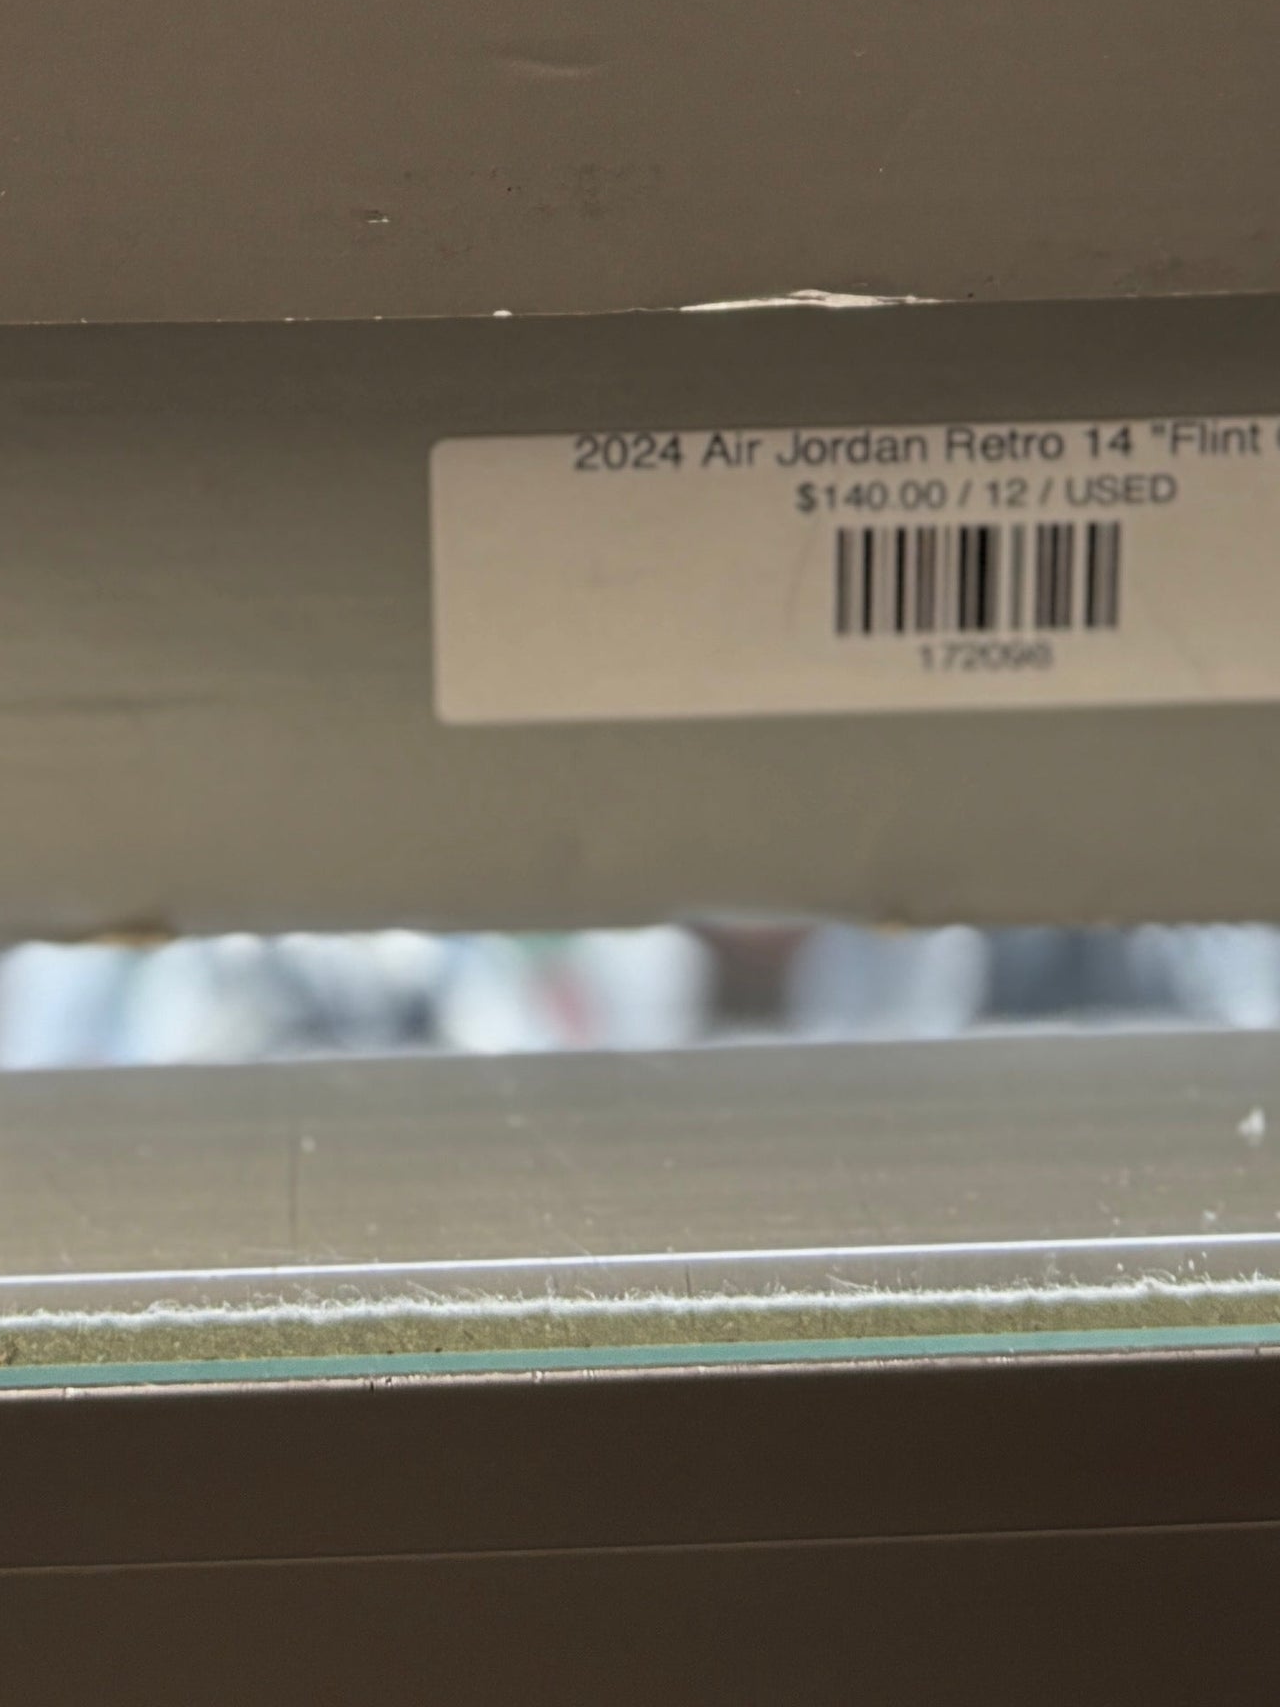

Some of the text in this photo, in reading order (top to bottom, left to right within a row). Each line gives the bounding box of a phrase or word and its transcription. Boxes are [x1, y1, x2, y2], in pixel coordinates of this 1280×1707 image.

[573, 431, 685, 471] 2024
[700, 431, 761, 467] Air
[776, 427, 928, 467] Jordan
[945, 425, 1066, 462] Retro
[1086, 425, 1135, 459] 14
[1150, 420, 1261, 457] "Flint
[796, 480, 948, 514] $140.00
[986, 478, 1029, 508] 12
[1065, 473, 1178, 507] USED
